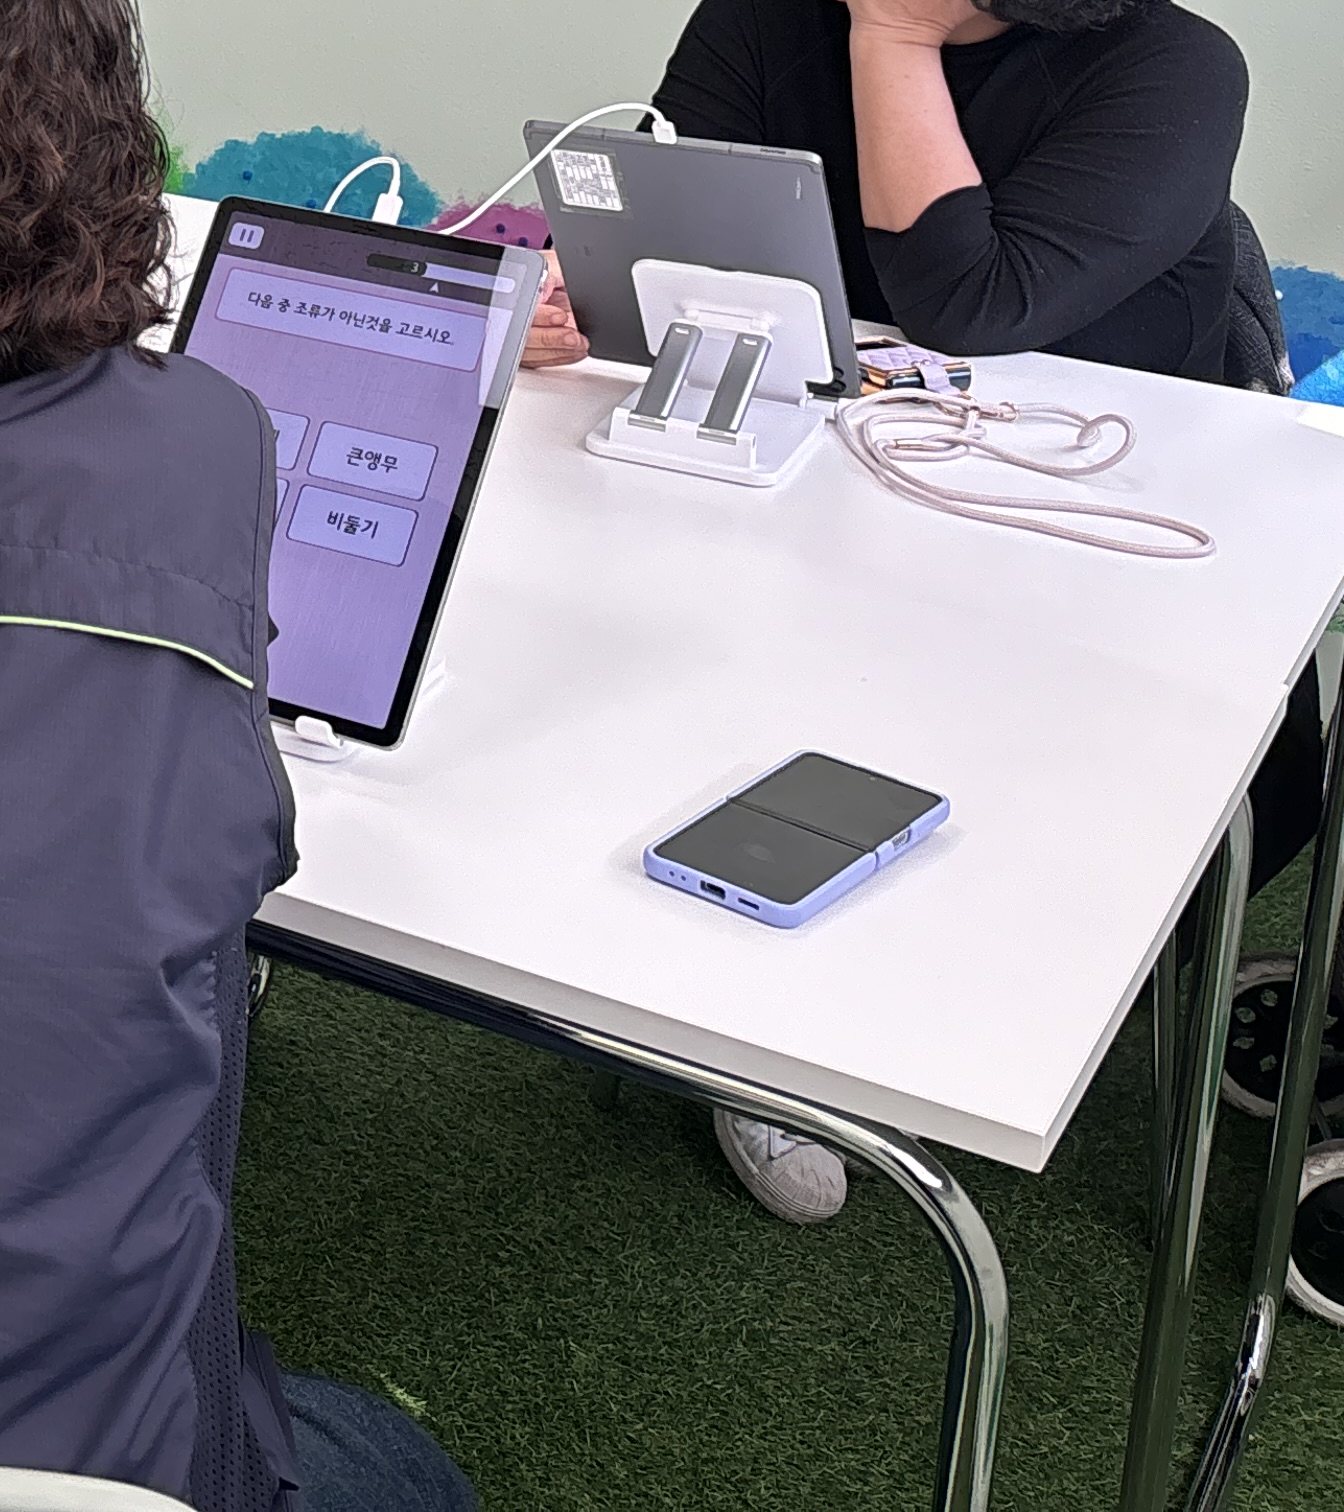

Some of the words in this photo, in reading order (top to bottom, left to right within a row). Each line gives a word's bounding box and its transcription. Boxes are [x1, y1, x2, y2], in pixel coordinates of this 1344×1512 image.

[411, 261, 420, 275] 3
[247, 291, 273, 308] 다음
[277, 298, 291, 313] 중
[294, 301, 336, 321] 조류가
[339, 310, 393, 334] 아닌것을
[345, 446, 399, 474] 큰앵무
[326, 510, 379, 539] 비둘기
